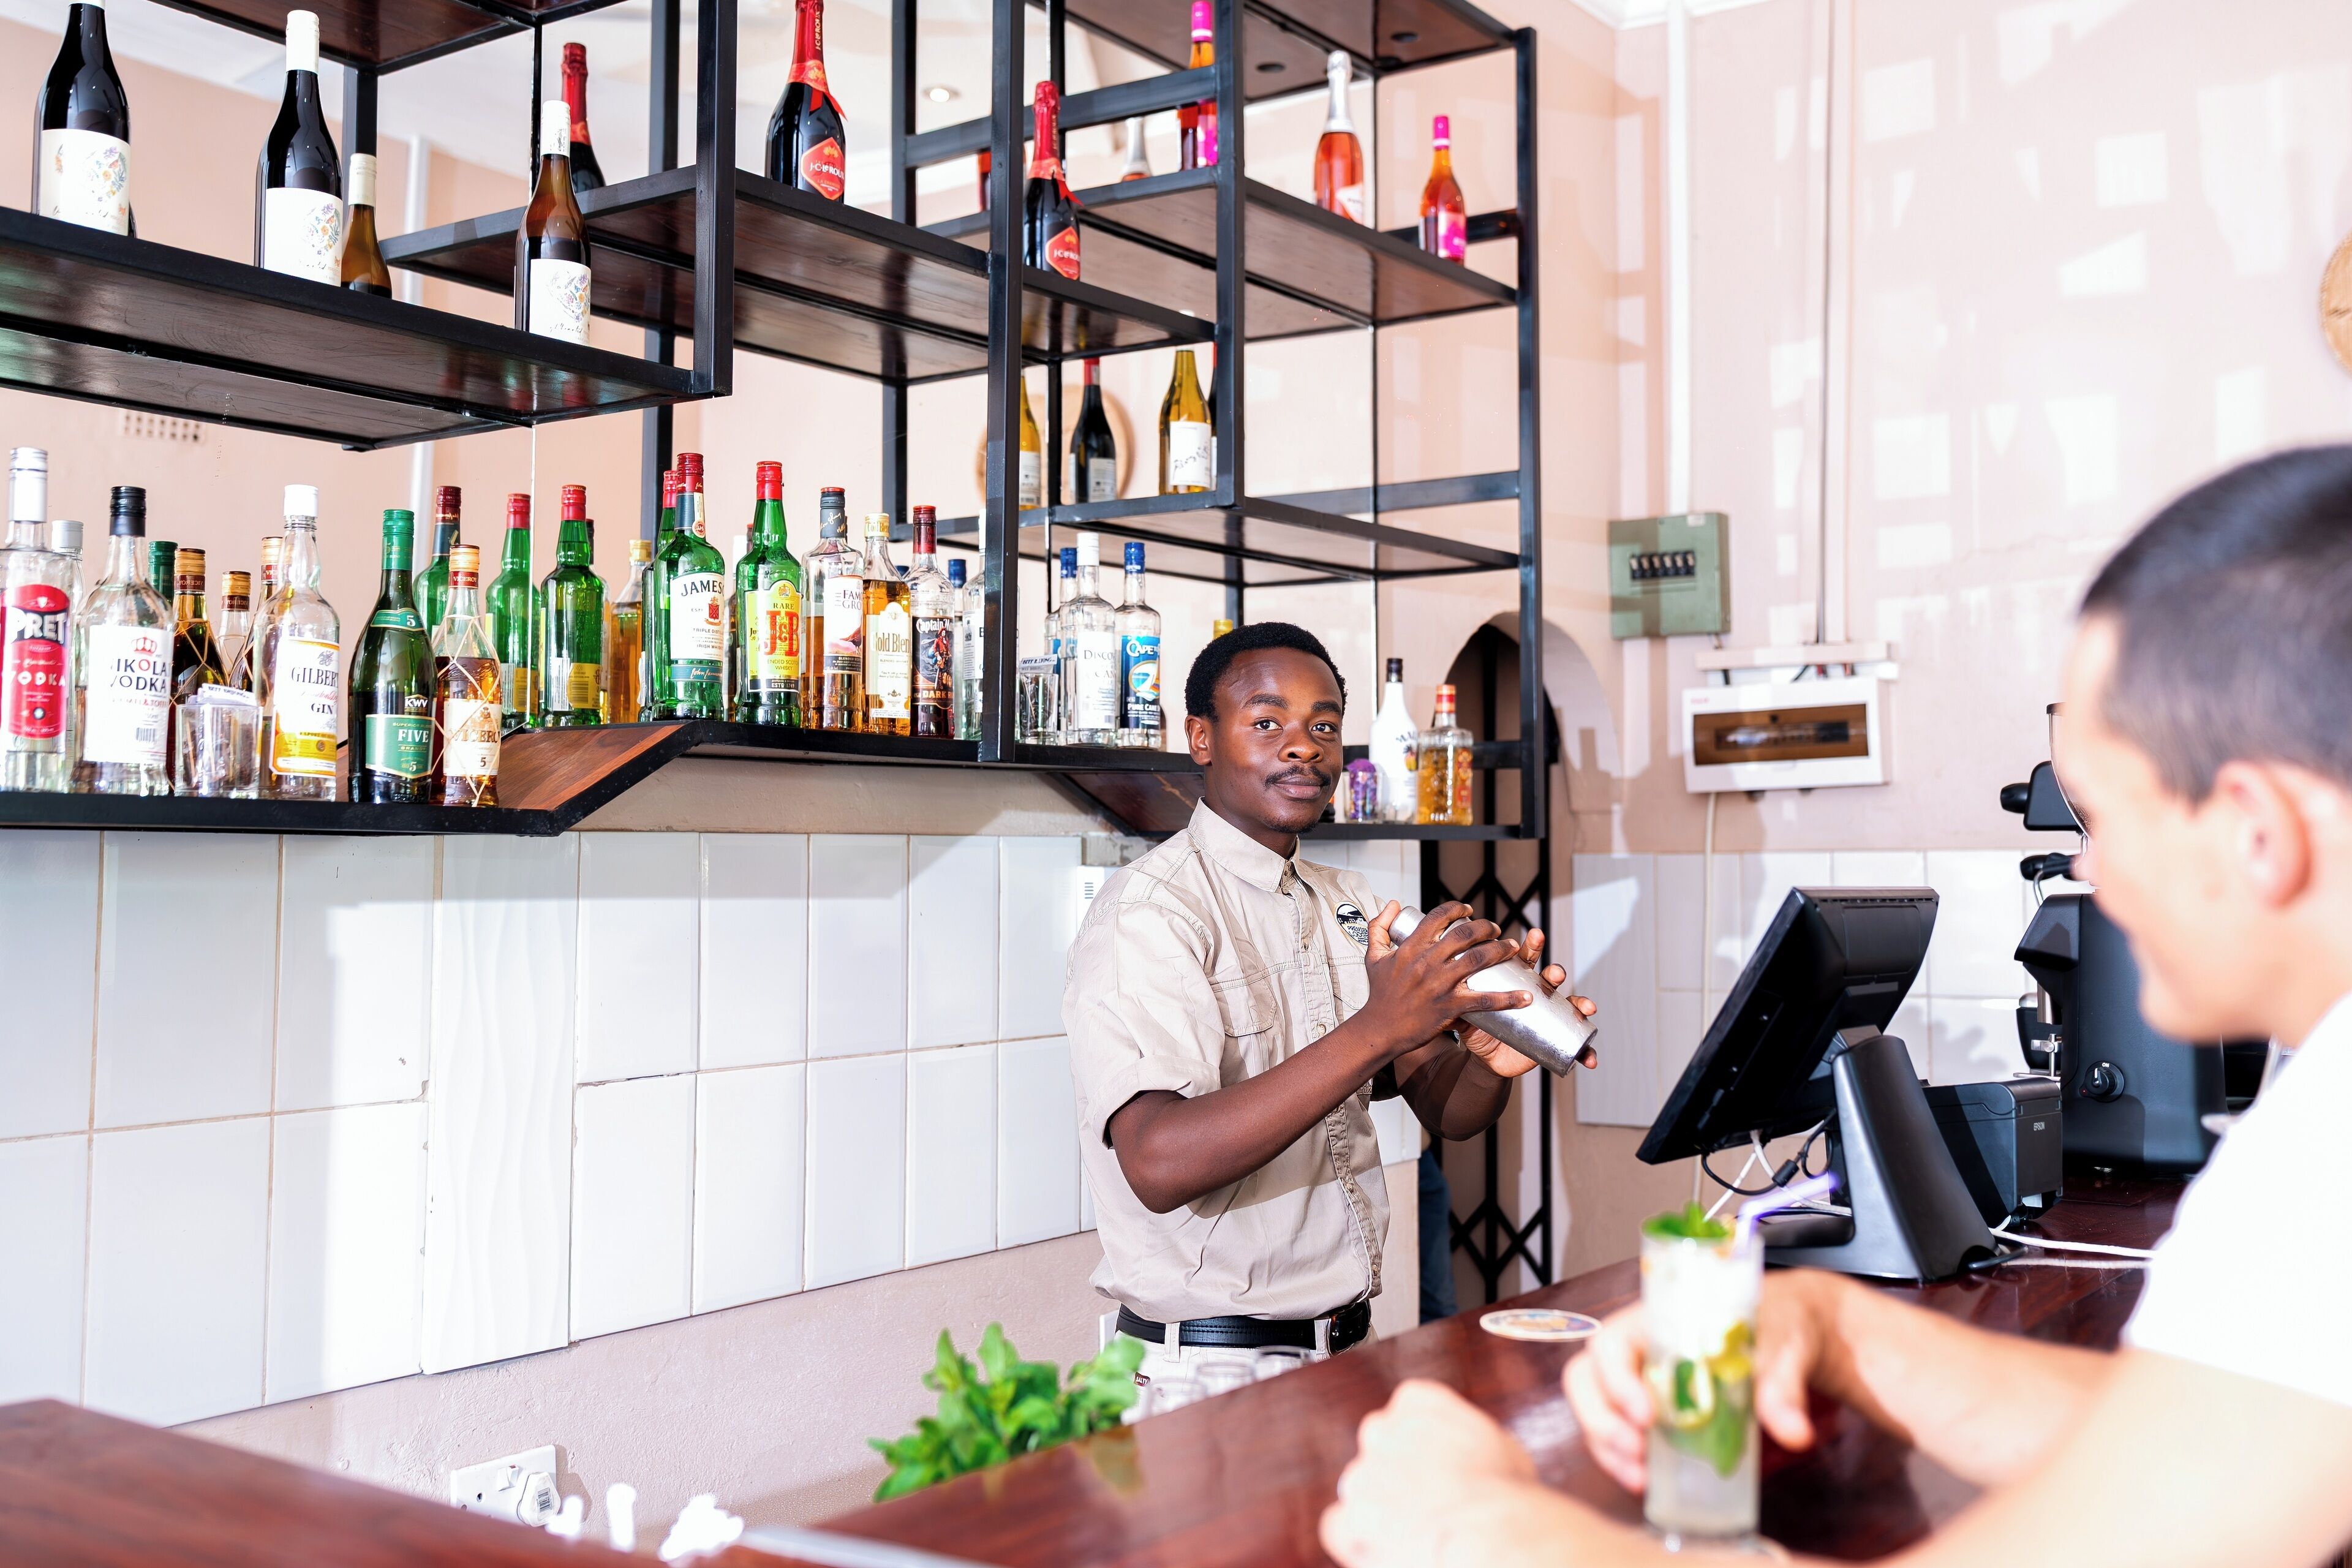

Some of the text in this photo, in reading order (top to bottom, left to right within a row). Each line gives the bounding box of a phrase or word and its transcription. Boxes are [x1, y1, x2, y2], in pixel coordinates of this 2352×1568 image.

[406, 615, 416, 627] 5
[916, 618, 943, 633] Captain
[764, 610, 799, 657] J&B
[922, 690, 946, 699] DARK
[404, 698, 428, 707] KWV
[311, 702, 334, 715] GIN
[398, 729, 429, 743] FIVE
[409, 761, 417, 772] 5
[480, 756, 487, 767] 5
[2033, 1121, 2045, 1131] EPSON
